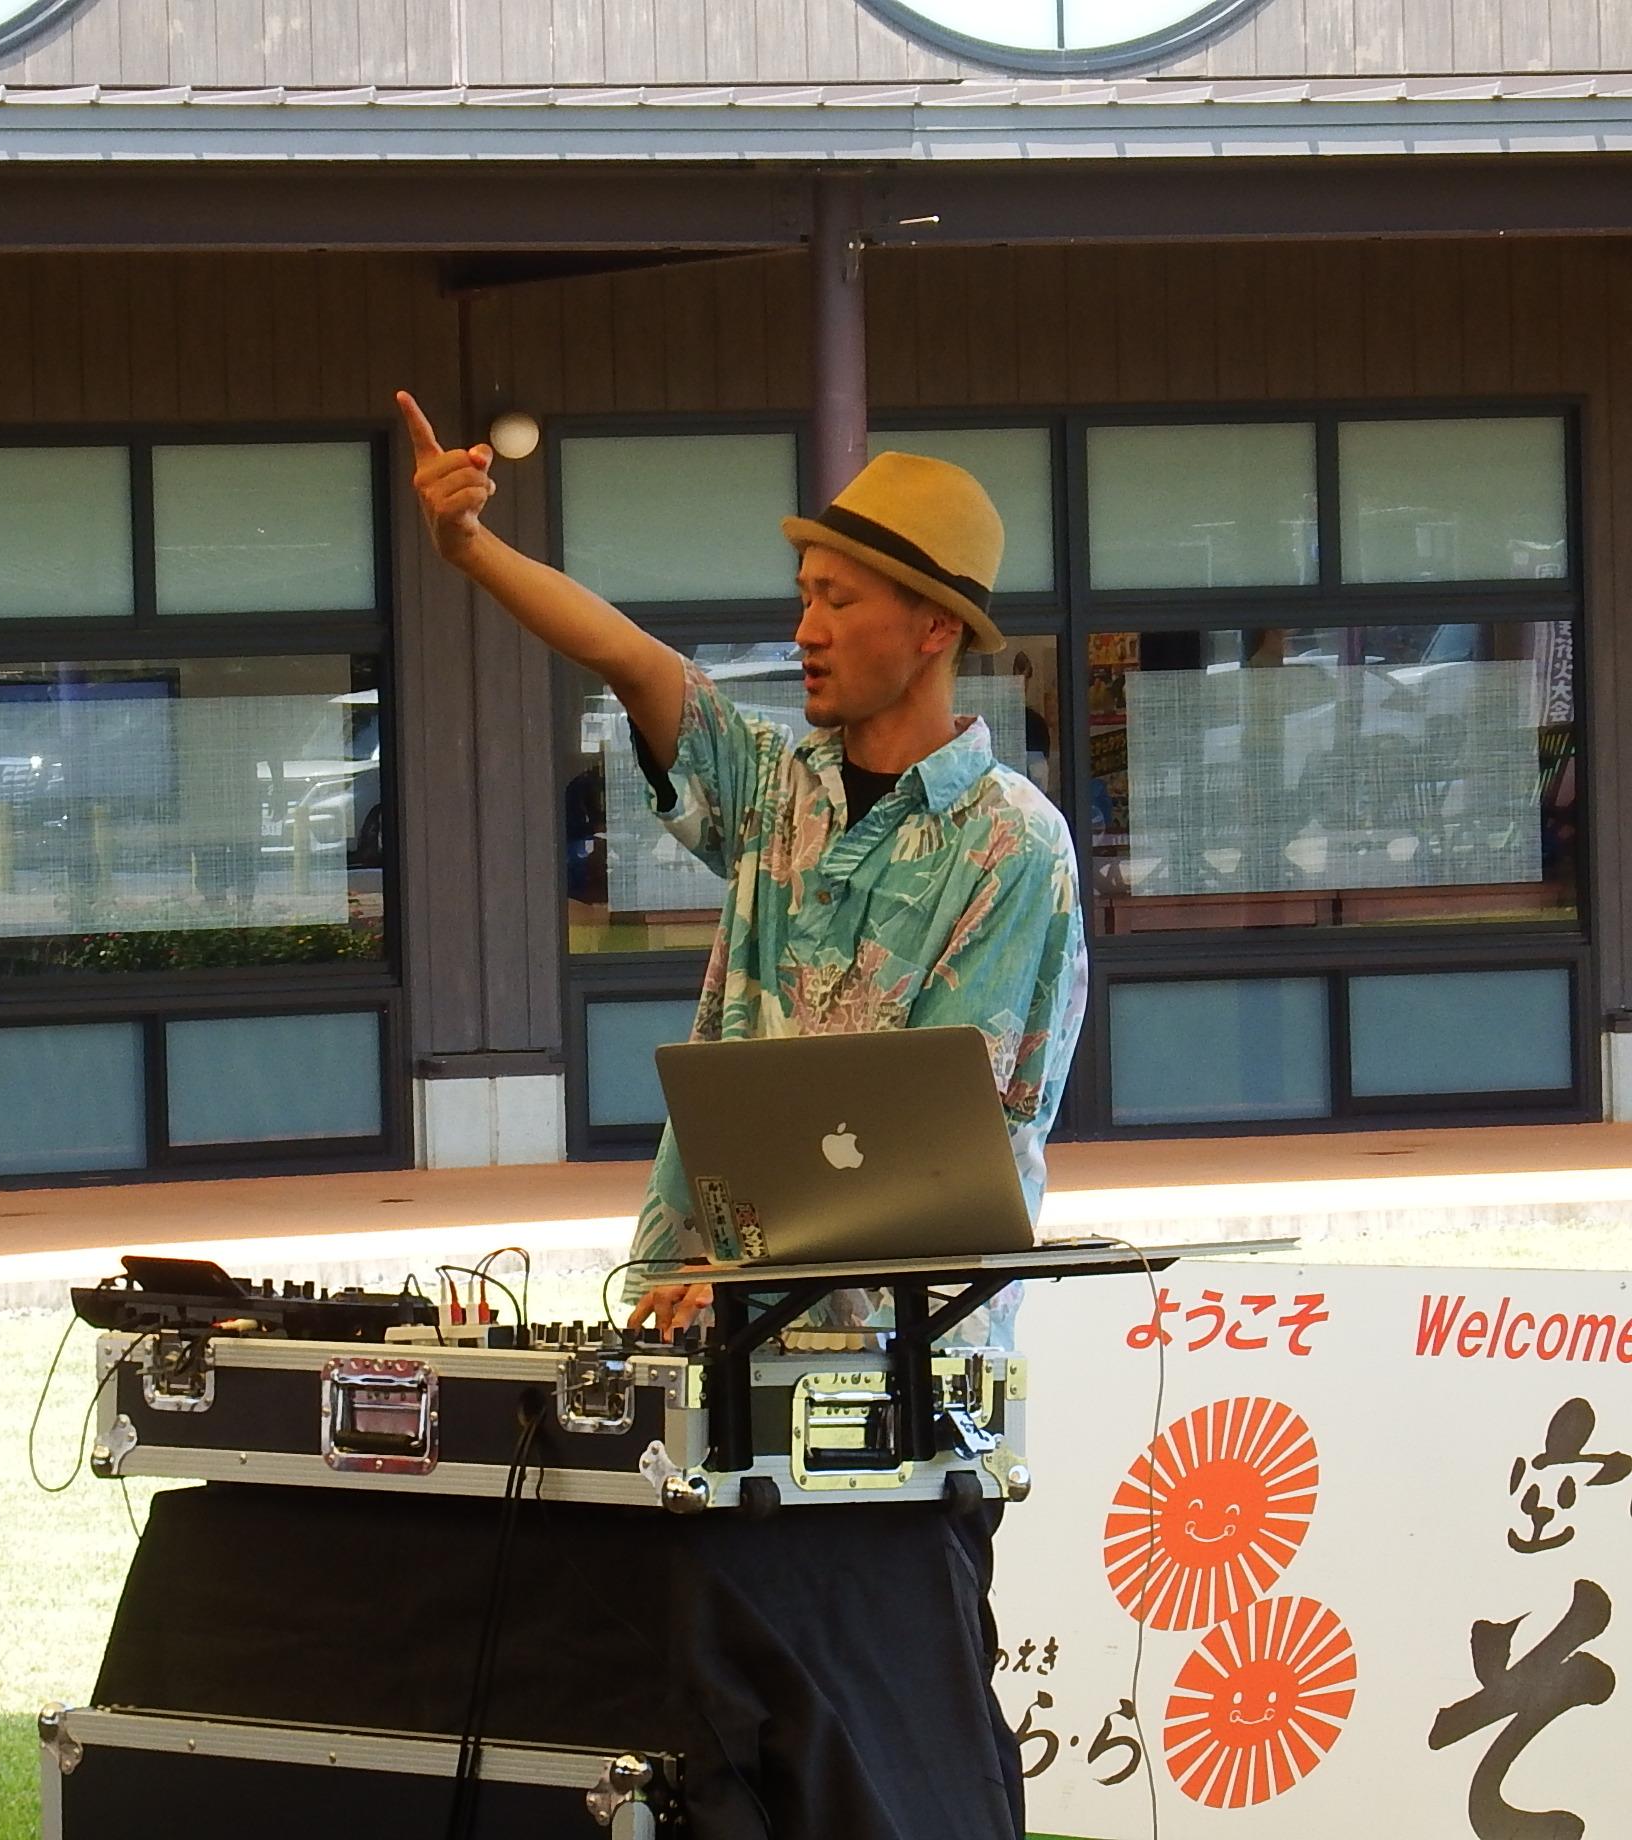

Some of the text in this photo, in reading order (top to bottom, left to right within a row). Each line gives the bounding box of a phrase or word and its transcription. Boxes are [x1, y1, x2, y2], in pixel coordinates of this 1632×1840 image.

[1126, 1288, 1330, 1356] ようこそ
[1415, 1294, 1632, 1363] Welcome
